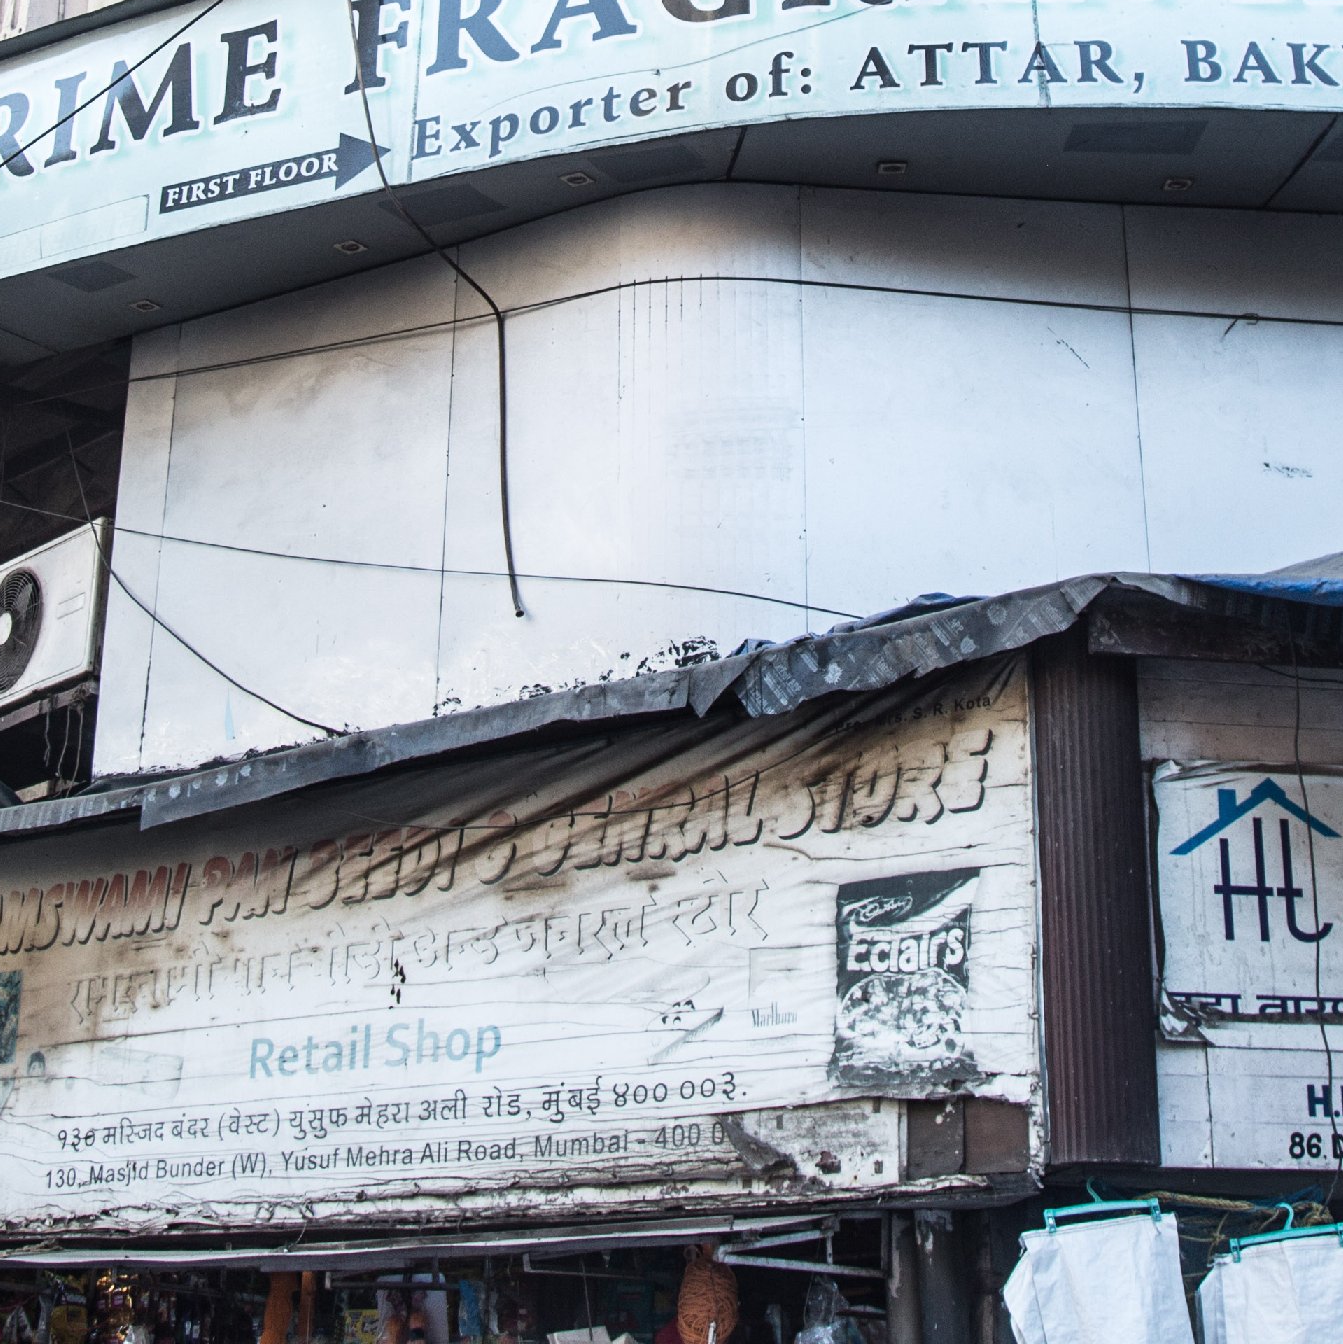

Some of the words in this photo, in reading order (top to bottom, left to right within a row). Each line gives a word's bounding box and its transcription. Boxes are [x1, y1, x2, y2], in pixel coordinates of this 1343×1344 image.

[412, 80, 693, 160] Exporter
[724, 50, 814, 103] of:
[849, 39, 1146, 94] ATTAR,
[167, 174, 241, 208] FIRST
[247, 152, 339, 191] FLOOR
[954, 694, 992, 712] Kota
[197, 845, 299, 927] PAN
[848, 928, 966, 974] Eclairs
[249, 1023, 372, 1080] Retail
[384, 1015, 503, 1077] Shop
[88, 1159, 149, 1187] Masjid
[155, 1157, 226, 1180] Bunder
[232, 1151, 274, 1182] (W),
[280, 1146, 341, 1172] Yusuf
[346, 1144, 414, 1168] Mehra
[419, 1140, 449, 1165] Ali
[456, 1136, 525, 1163] Road,
[533, 1129, 629, 1158] Mumbai
[653, 1122, 701, 1150] 400
